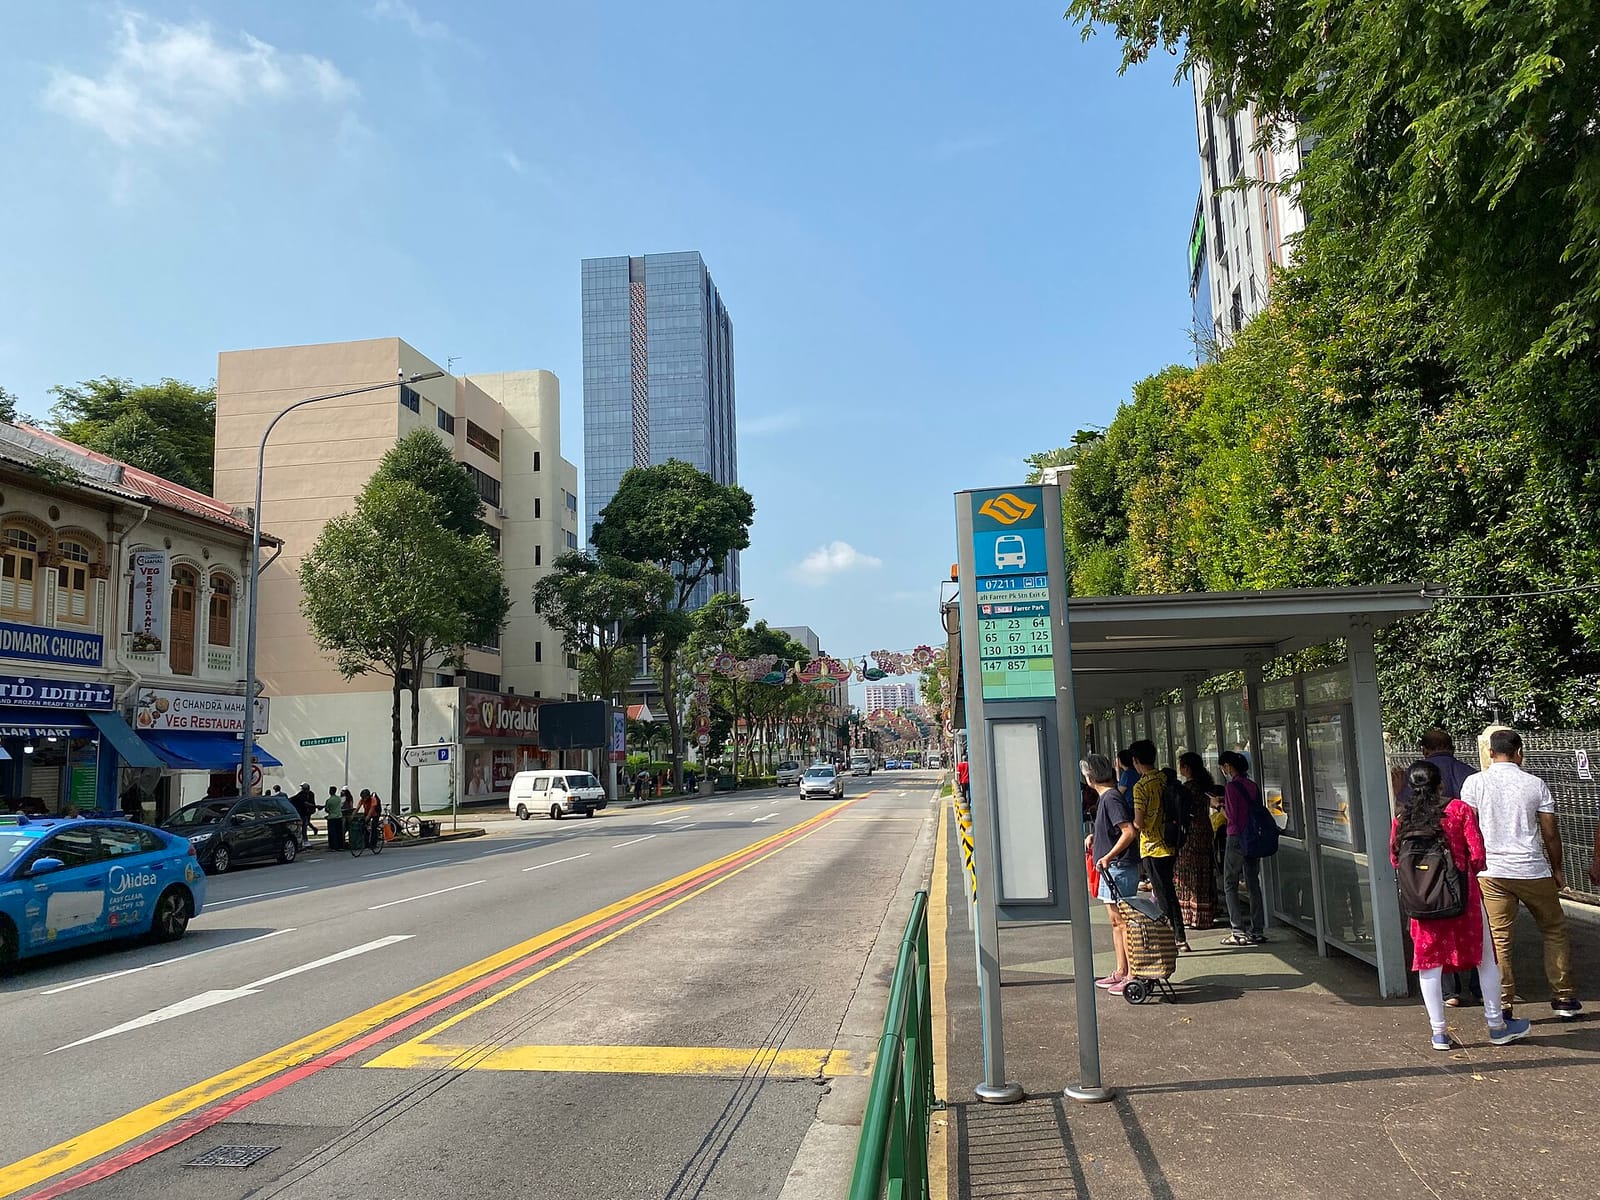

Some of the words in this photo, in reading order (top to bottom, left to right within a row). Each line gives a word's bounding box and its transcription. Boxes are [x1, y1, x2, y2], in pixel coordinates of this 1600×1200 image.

[985, 579, 1015, 590] 07211
[985, 621, 996, 630] 21
[1008, 620, 1020, 629] 23
[1032, 618, 1045, 628] 64
[985, 633, 998, 643] 65
[1009, 632, 1021, 642] 67
[1030, 631, 1049, 641] 125
[0, 629, 48, 655] DMARK
[51, 636, 100, 660] CHURCH
[984, 646, 1002, 656] 130
[1007, 645, 1026, 655] 139
[1031, 644, 1049, 654] 141
[984, 661, 1002, 671] 147
[1007, 660, 1026, 670] 857
[182, 699, 221, 710] CHANDRA
[224, 703, 246, 713] MAHA
[0, 728, 30, 737] LAM
[34, 728, 71, 737] MART
